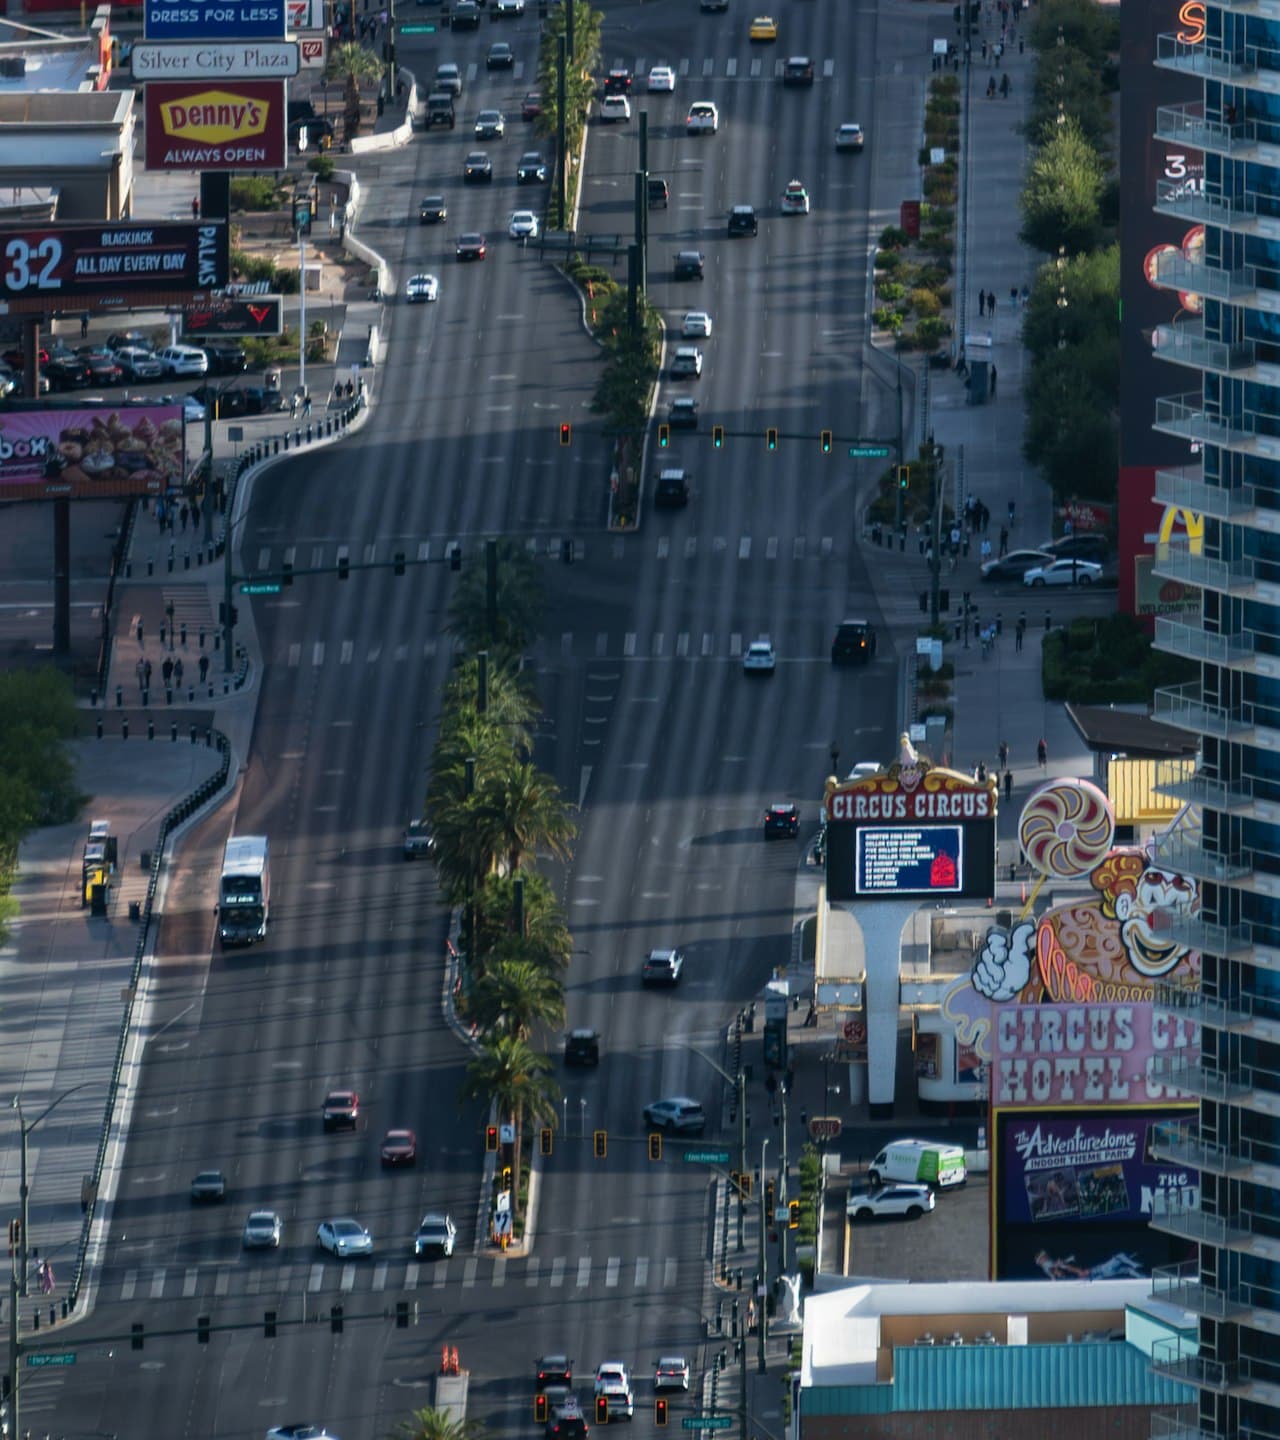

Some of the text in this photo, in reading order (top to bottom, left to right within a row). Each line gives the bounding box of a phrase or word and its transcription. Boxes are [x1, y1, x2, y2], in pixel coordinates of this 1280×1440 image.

[151, 9, 278, 23] DRESS FOR LESS
[139, 49, 289, 72] Silver City Plaza
[170, 101, 261, 130] Denny's
[163, 148, 265, 163] ALWAYS OPEN
[101, 232, 153, 247] BLACKJACK
[4, 237, 63, 291] 3:2
[75, 253, 186, 274] ALL DAY EVERY DAY
[198, 227, 217, 287] PALMS
[833, 792, 988, 819] CIRCUS CIRCUS
[999, 1008, 1135, 1053] CIRCUS
[1000, 1057, 1129, 1102] HOTEL
[1016, 1123, 1136, 1159] Adventuredome
[1030, 1149, 1130, 1169] INDOOR THEME PARK
[1159, 1173, 1188, 1185] THE
